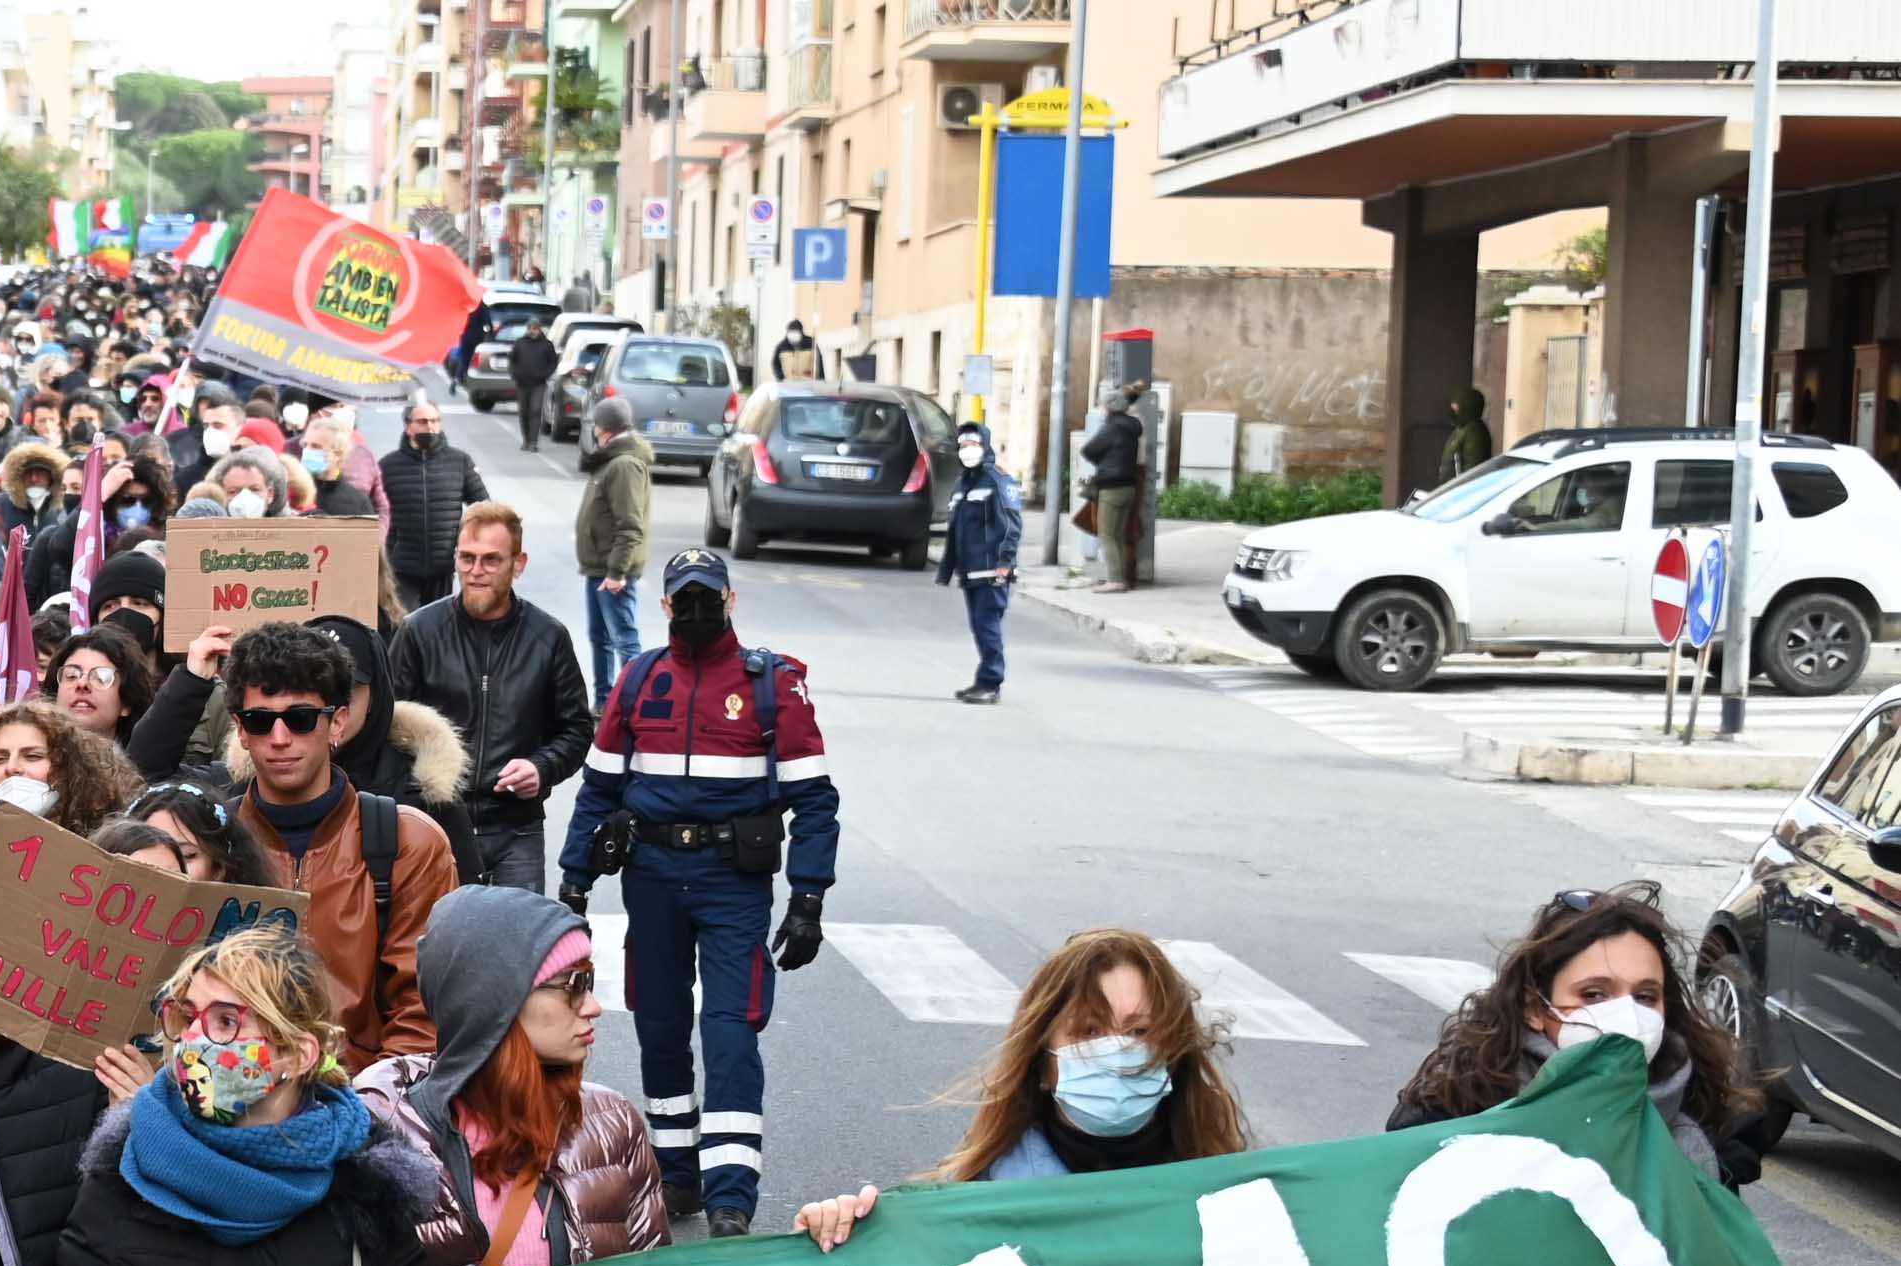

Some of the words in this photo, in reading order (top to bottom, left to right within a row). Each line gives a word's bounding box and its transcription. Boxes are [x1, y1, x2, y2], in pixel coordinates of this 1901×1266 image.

[804, 233, 834, 276] P
[324, 260, 398, 304] AMBIEN
[318, 285, 390, 329] TALISTA
[211, 313, 289, 362] FORUM
[8, 835, 44, 882] 1
[60, 864, 205, 947] SOLO
[41, 918, 145, 988] VALE
